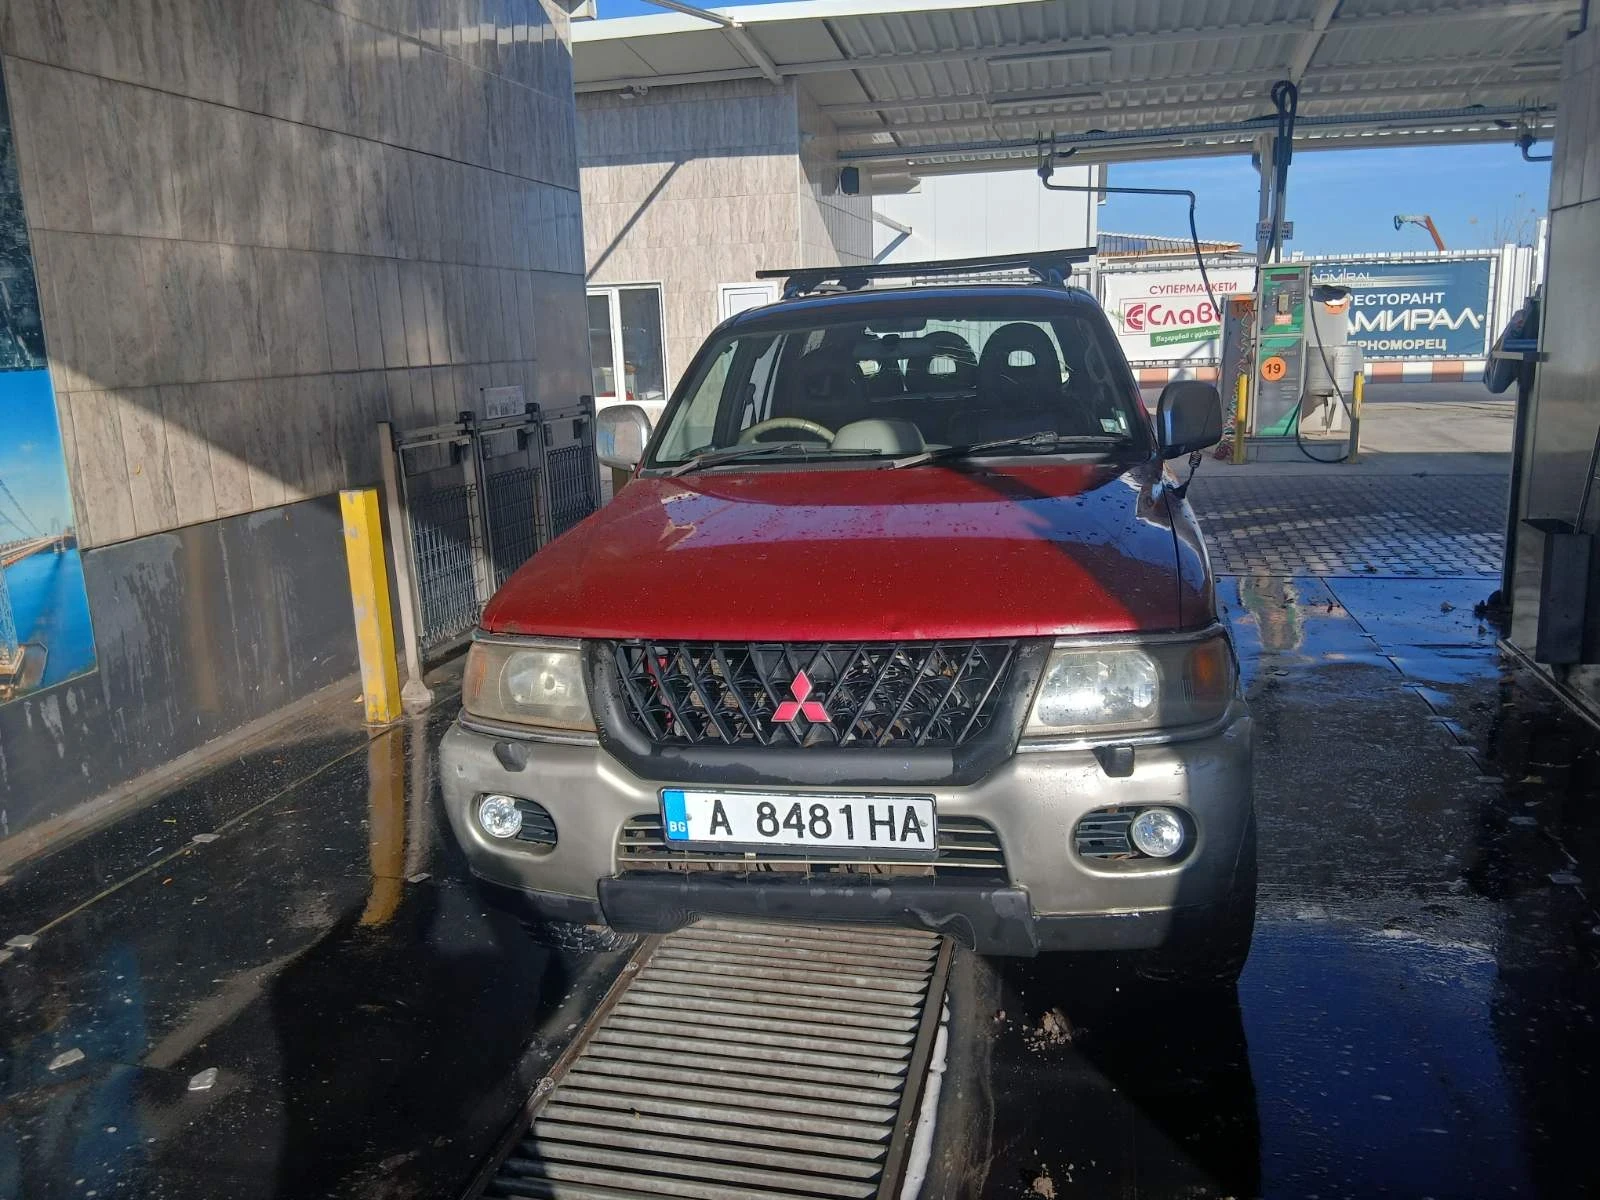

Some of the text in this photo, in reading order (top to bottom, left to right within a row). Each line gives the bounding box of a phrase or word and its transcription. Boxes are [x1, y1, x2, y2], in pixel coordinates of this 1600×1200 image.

[1149, 281, 1237, 295] СУПЕРМАКЕТИ
[1349, 292, 1445, 306] ЕСТОРАНТ
[1265, 363, 1281, 374] 19
[709, 799, 733, 836] A
[669, 821, 686, 832] BG
